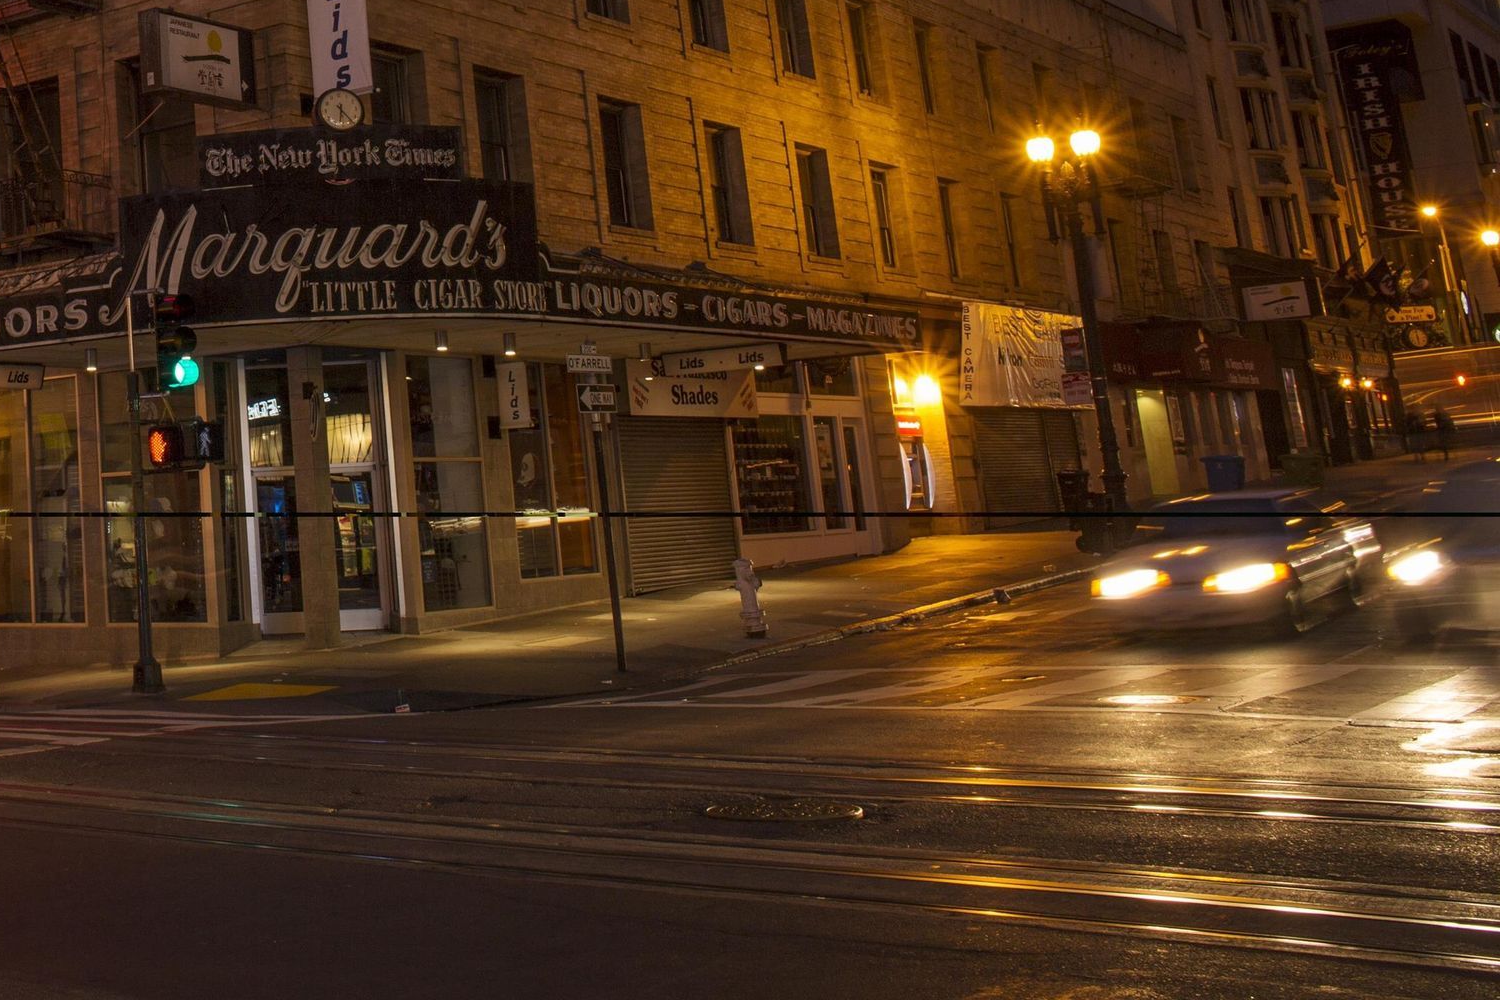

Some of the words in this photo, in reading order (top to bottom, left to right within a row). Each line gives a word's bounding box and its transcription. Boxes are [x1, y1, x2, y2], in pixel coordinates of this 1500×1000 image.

[205, 148, 254, 178] The
[258, 143, 312, 173] New
[316, 138, 380, 175] York
[384, 137, 456, 168] Times
[98, 200, 507, 326] Marquard's
[414, 279, 483, 310] CIGAR
[555, 280, 678, 319] LIQUORS
[701, 294, 788, 328] CIGARS
[806, 305, 917, 341] MAGAZINES
[568, 357, 611, 370] O'FARRELL
[651, 361, 665, 377] Sa
[680, 357, 704, 369] Lids
[738, 352, 764, 364] Lids
[964, 349, 973, 400] CAMERA
[8, 369, 30, 385] Lids
[507, 370, 520, 421] Lids
[671, 385, 718, 405] Shades
